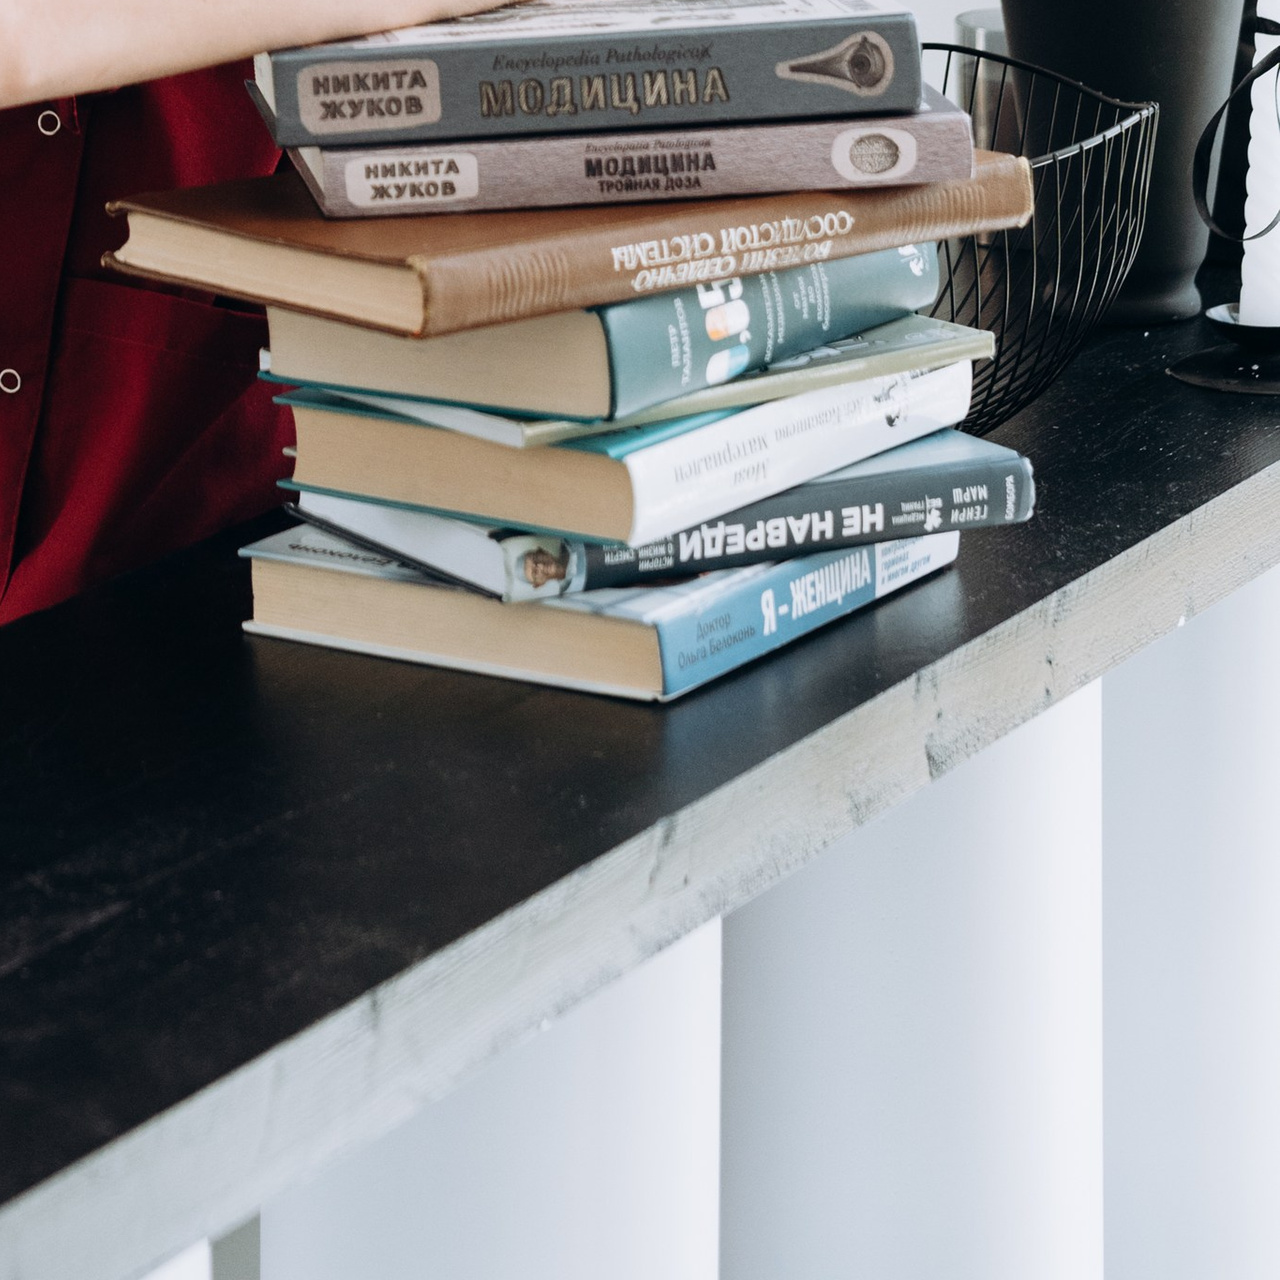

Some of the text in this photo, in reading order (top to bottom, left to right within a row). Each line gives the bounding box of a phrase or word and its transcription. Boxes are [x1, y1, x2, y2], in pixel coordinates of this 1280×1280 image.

[492, 49, 600, 75] Encyclopedia
[312, 69, 427, 95] НИКИТА
[479, 66, 730, 118] МОДИЦИНА
[320, 95, 423, 120] ЖУКОВ
[364, 159, 459, 179] НИКИТА
[584, 151, 716, 177] МОДИЦИНА
[370, 180, 456, 201] ЖУКОВ
[598, 175, 701, 192] ТРОЙНАЯ ДОЗА
[611, 232, 716, 271] СИСТЕМЫ
[952, 484, 988, 504] МАРШ
[950, 504, 988, 524] ГЕНРИ
[678, 502, 885, 563] НЕ НАВРЕДИ
[638, 556, 673, 572] ИСТОРИИ
[760, 588, 778, 637] Я
[789, 548, 872, 621] ЖЕНЩИНА
[696, 612, 731, 641] Доктор
[677, 624, 756, 670] Ольга Белоконь
